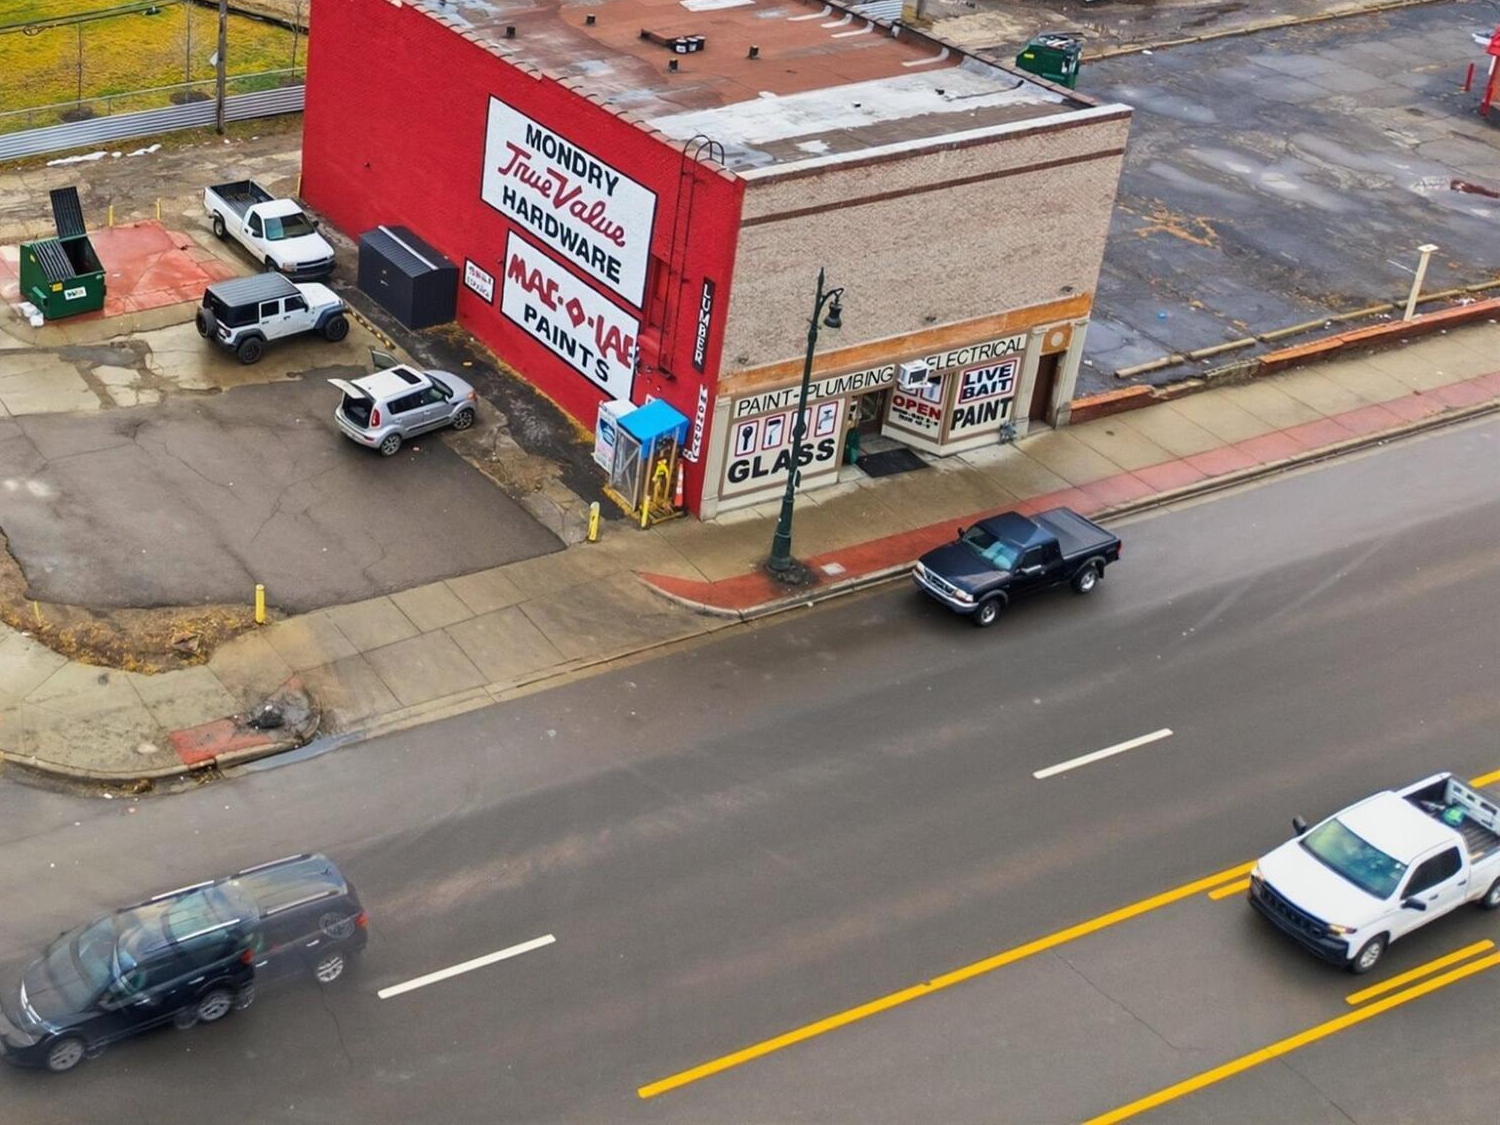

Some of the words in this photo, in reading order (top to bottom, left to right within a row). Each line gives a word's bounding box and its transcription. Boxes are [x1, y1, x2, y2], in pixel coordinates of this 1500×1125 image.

[525, 123, 619, 196] MONDRY
[502, 185, 621, 285] HARDWARE
[524, 303, 609, 382] PAINTS
[694, 283, 711, 365] LUMBER
[926, 337, 1025, 372] ELECTRICAL
[963, 364, 1012, 385] LIVE
[892, 395, 941, 420] OPEN
[961, 377, 1013, 399] BAIT
[693, 395, 707, 451] MONDRY
[950, 397, 1013, 430] PAINT
[727, 438, 835, 483] GLASS
